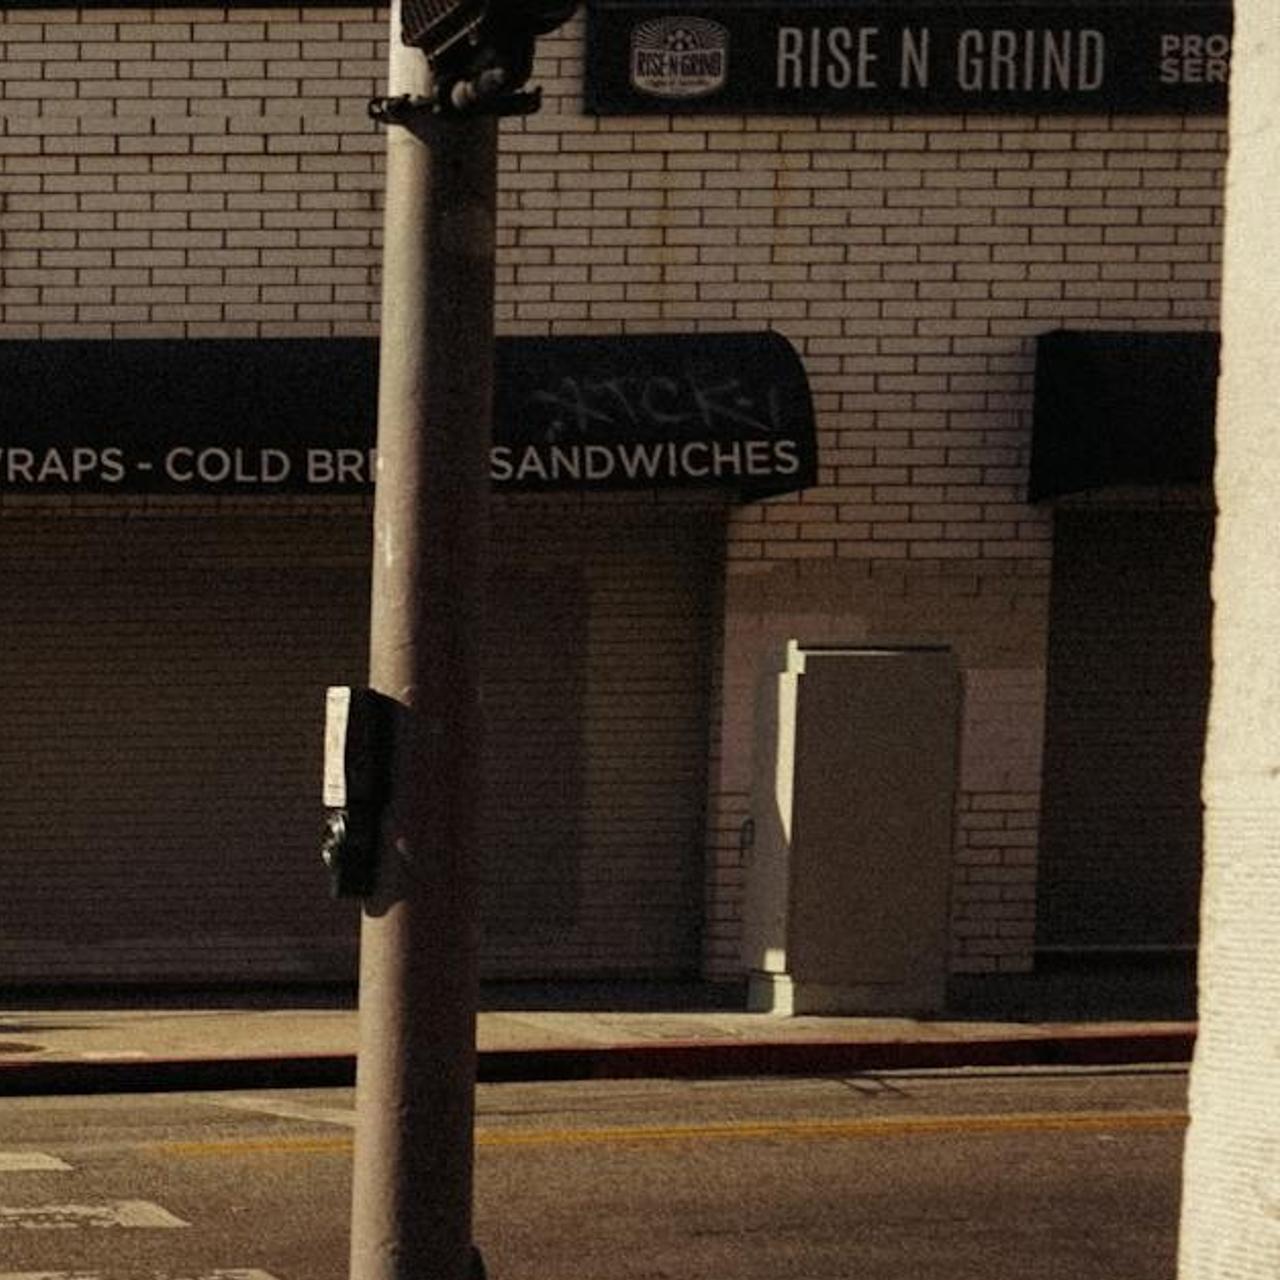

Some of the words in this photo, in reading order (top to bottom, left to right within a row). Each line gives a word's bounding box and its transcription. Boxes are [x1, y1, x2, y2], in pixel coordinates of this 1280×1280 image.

[776, 26, 878, 89] RISE
[900, 28, 929, 89] N
[956, 29, 1105, 92] GRIND
[164, 447, 291, 485] COLD
[489, 440, 800, 481] SANDWICHES
